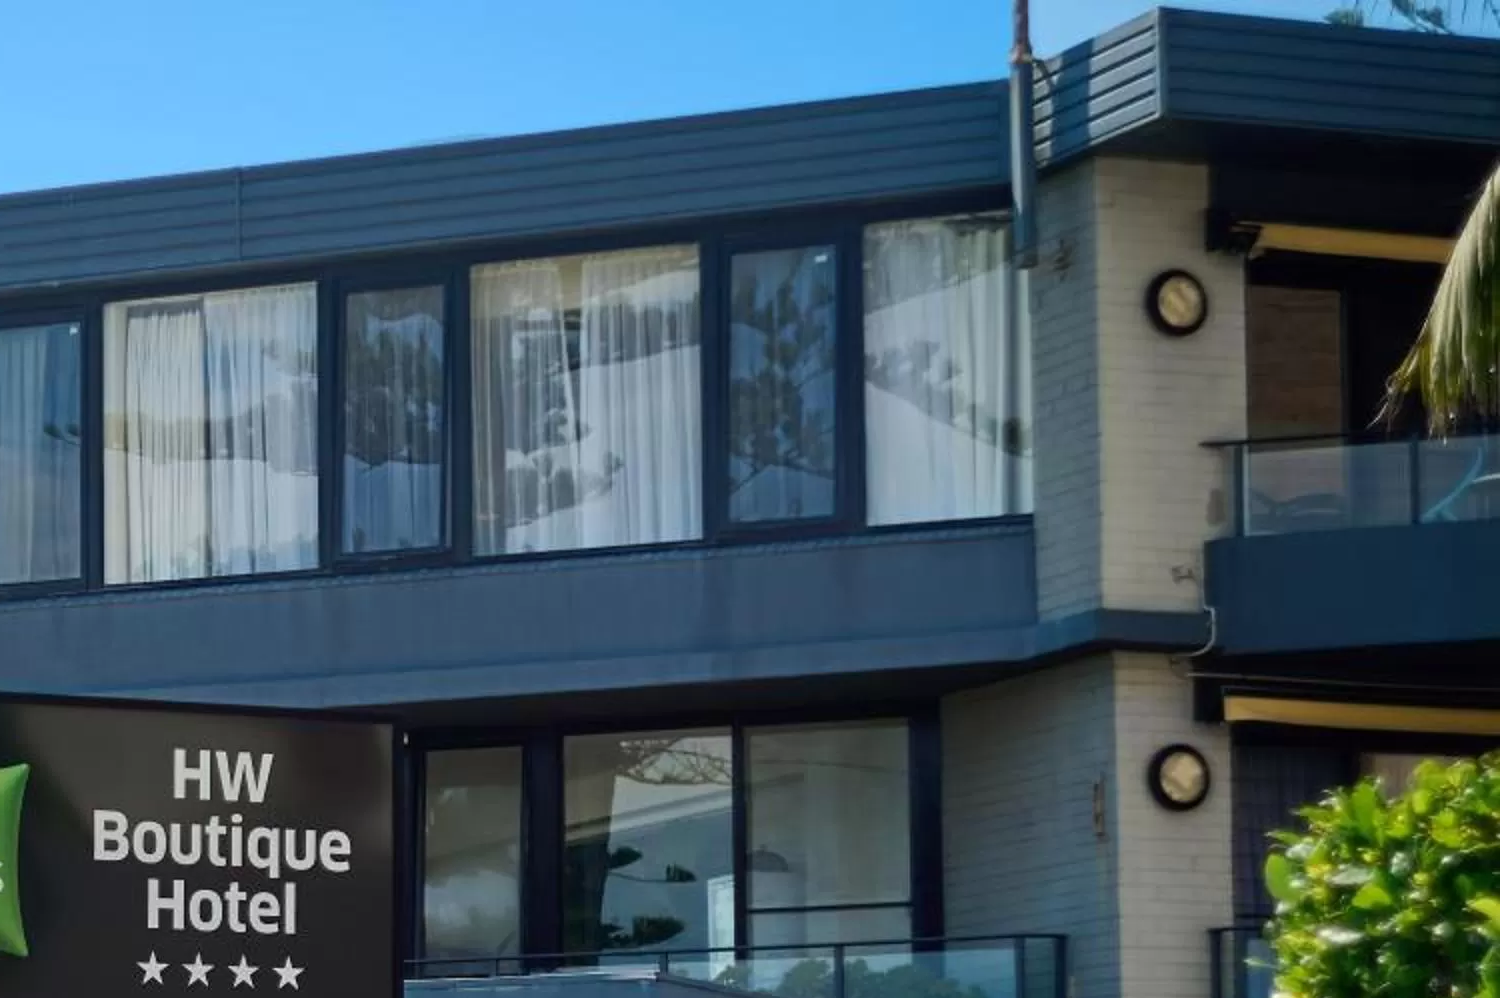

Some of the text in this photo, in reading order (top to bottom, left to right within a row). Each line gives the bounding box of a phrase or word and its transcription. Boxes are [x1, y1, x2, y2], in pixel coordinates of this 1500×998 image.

[173, 747, 274, 803] HW
[93, 809, 352, 880] Boutique
[146, 878, 297, 935] Hotel
